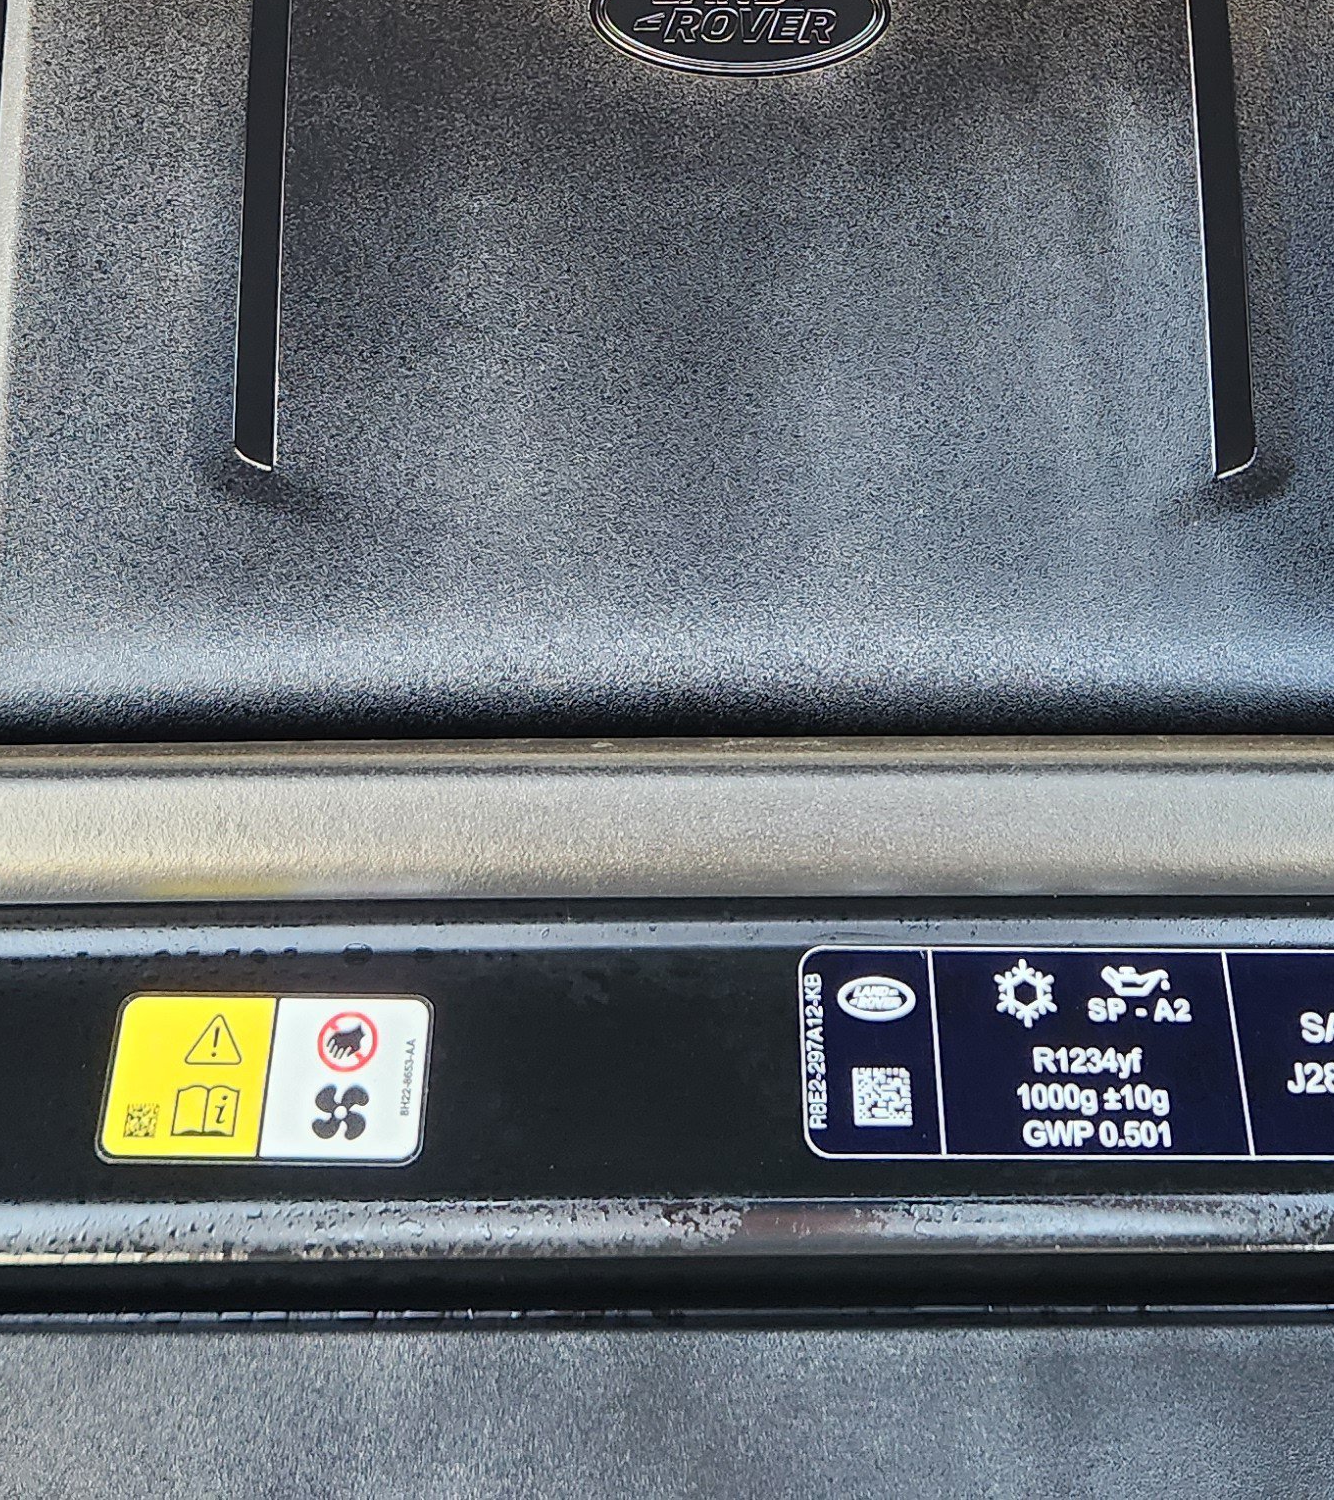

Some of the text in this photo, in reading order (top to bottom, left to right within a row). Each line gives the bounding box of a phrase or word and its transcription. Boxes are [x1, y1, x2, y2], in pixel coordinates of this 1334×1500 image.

[663, 8, 837, 44] ROVER
[1087, 998, 1125, 1023] SP
[1153, 998, 1192, 1023] A2
[802, 972, 829, 1130] R8E2-297A12-KB
[1032, 1046, 1144, 1078] R1234yf
[1016, 1084, 1170, 1116] 1000g ±10g
[1022, 1120, 1172, 1148] GWP 0.501
